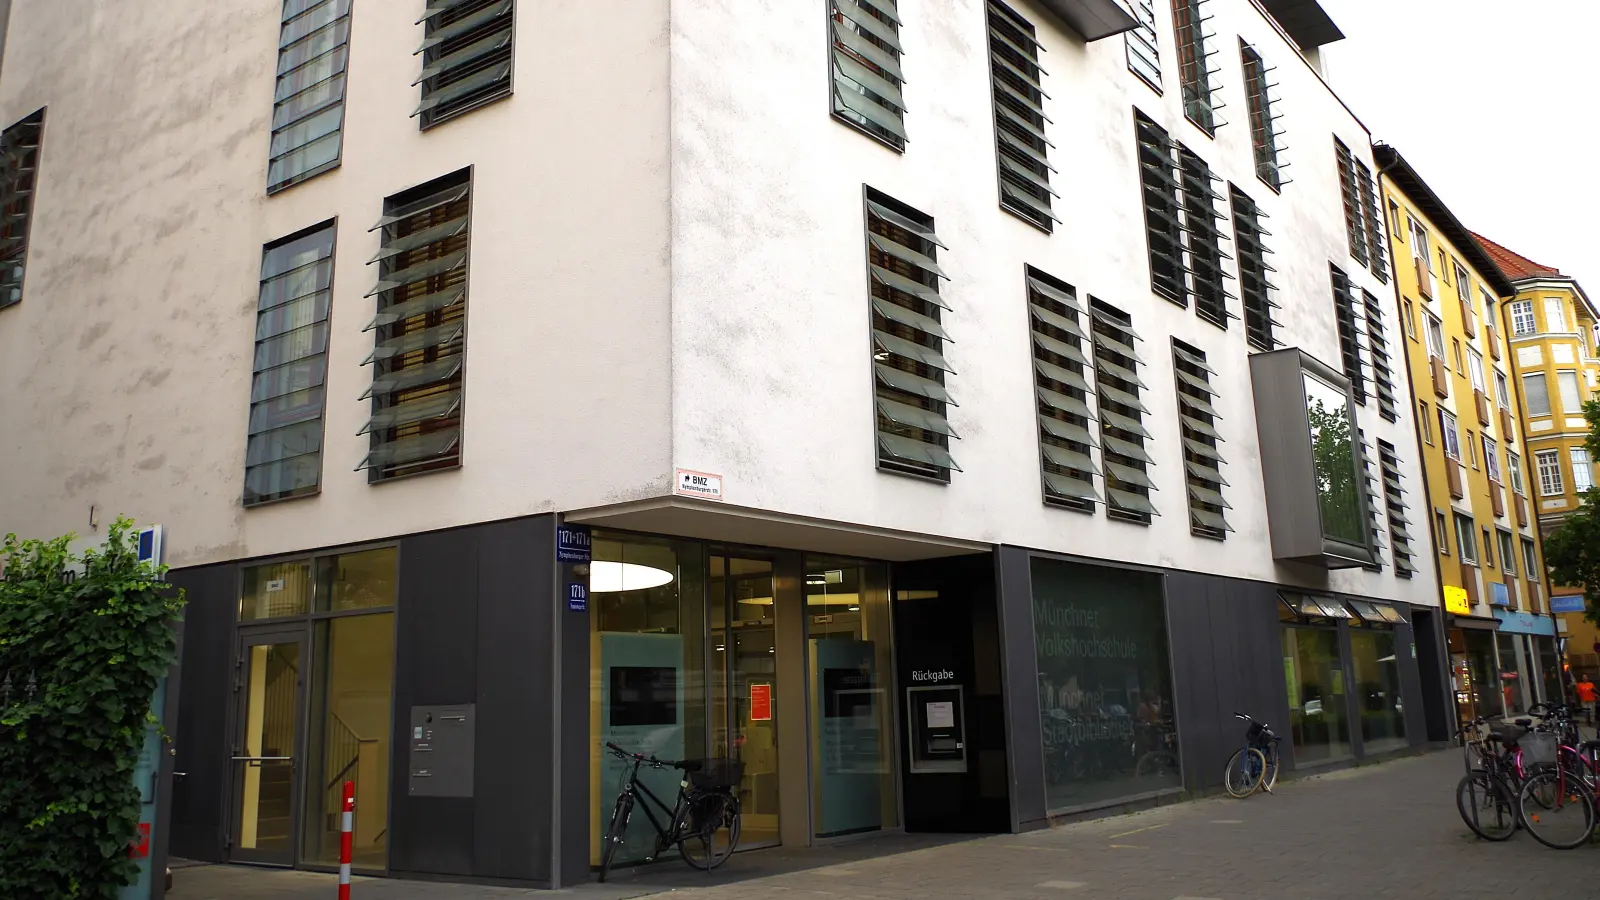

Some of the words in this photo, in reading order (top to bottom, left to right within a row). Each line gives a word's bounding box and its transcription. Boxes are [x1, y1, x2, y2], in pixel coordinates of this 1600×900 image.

[692, 475, 708, 486] BMZ
[571, 585, 586, 599] 171b
[1034, 598, 1099, 628] Münchner
[1036, 631, 1137, 659] Volkshochschule
[912, 668, 954, 683] Rückgabe
